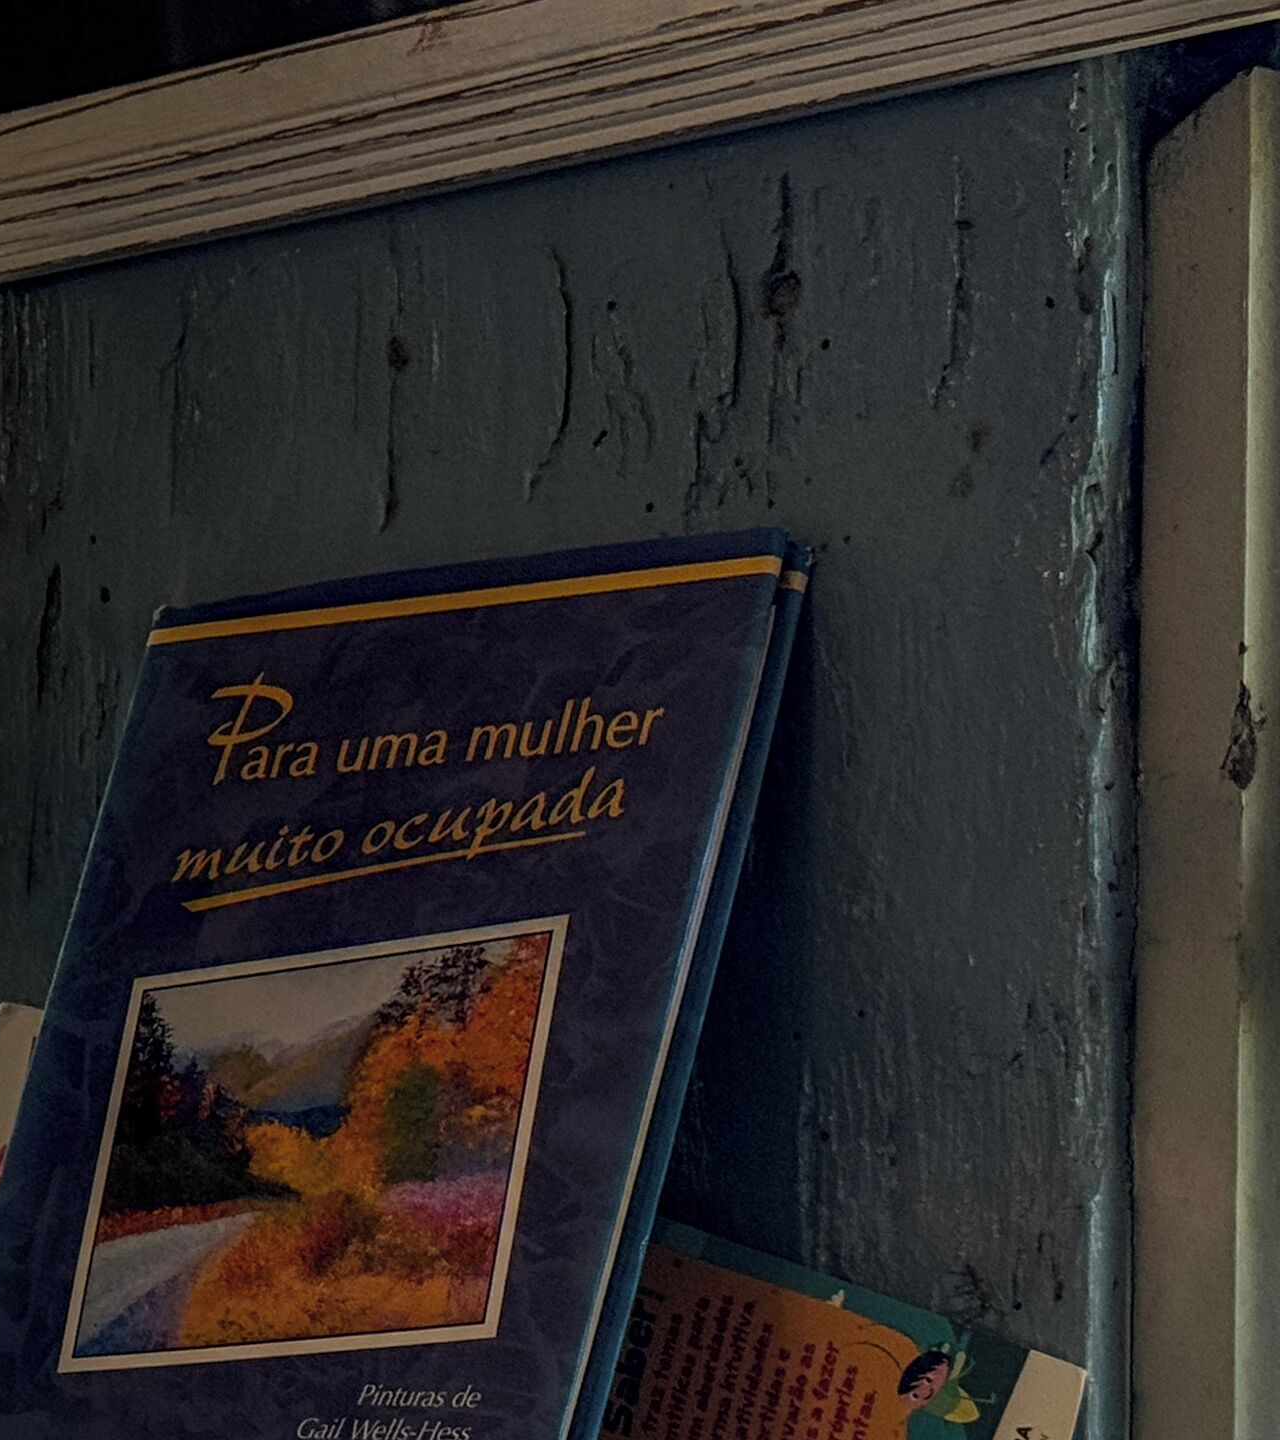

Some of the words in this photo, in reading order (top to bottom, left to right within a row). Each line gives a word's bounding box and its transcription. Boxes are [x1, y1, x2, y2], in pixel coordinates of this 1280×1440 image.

[207, 671, 318, 785] Para
[337, 729, 447, 773] uma
[464, 696, 665, 762] mulher
[171, 824, 344, 882] muito
[361, 766, 626, 860] ocupada
[721, 1301, 756, 1393] intuitiva
[801, 1344, 816, 1369] as
[813, 1341, 840, 1400] fazer
[357, 1383, 445, 1408] Pinturas
[451, 1384, 482, 1408] de
[296, 1417, 345, 1440] Gail
